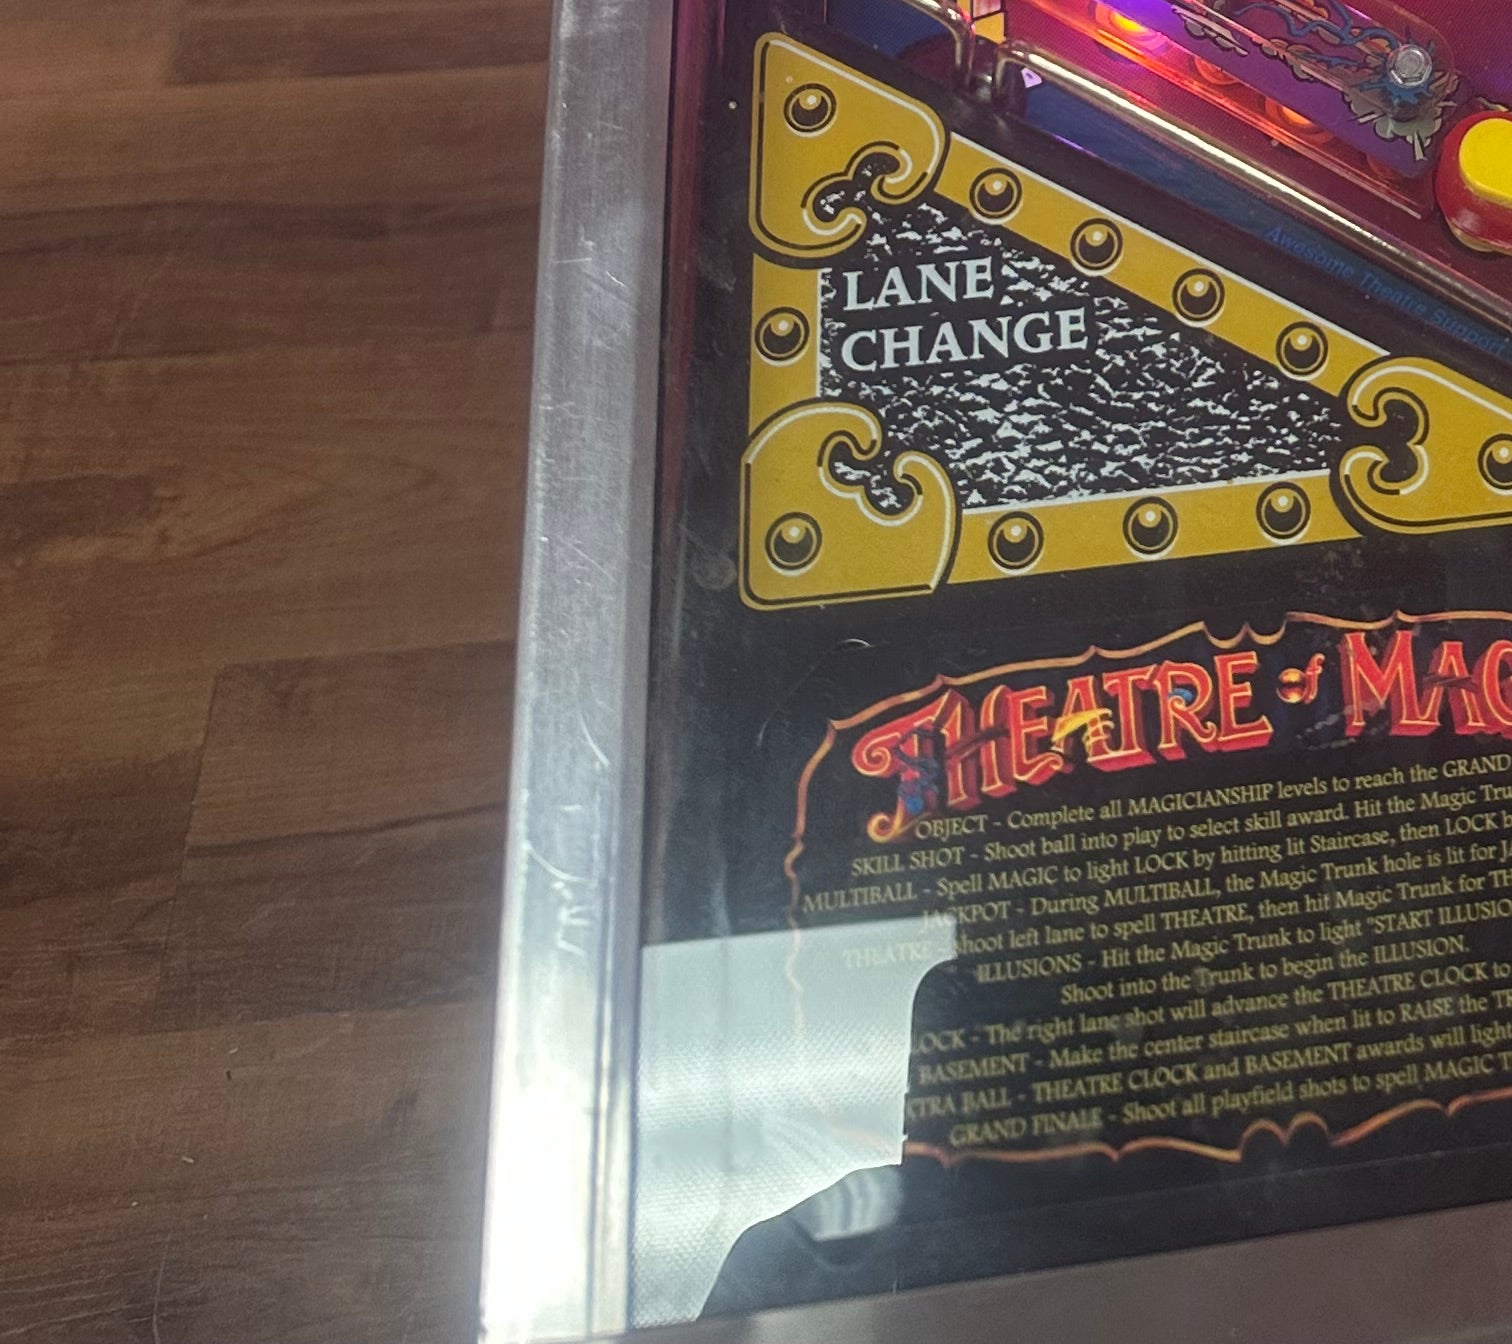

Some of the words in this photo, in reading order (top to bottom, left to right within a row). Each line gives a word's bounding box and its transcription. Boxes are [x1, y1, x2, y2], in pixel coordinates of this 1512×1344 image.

[843, 257, 994, 311] LANE
[841, 307, 1089, 372] CHANGE
[852, 646, 1274, 843] THEATRE
[1276, 653, 1326, 704] of
[850, 855, 904, 876] SKILL
[908, 848, 966, 870] SHOT
[983, 840, 1036, 861] Shoot
[1041, 835, 1077, 854] ball
[1081, 830, 1118, 849] into
[1123, 825, 1164, 849] play
[1166, 822, 1186, 839] to
[1188, 816, 1239, 836] select
[1244, 811, 1282, 830] skill
[1285, 803, 1349, 825] award.
[1354, 799, 1382, 817] Hit
[1387, 795, 1416, 813] the
[1419, 787, 1477, 813] Magic
[915, 816, 990, 844] OBJECT
[1007, 804, 1096, 833] Complete
[1098, 801, 1122, 818] all
[1126, 782, 1275, 815] MAGICIANSHIP
[1277, 776, 1327, 797] levels
[1332, 773, 1350, 790] to
[1354, 767, 1404, 788] reach
[1409, 763, 1439, 781] the
[1442, 754, 1512, 777] GRAND
[802, 882, 917, 910] MULTIBALL
[936, 874, 983, 899] Spell
[987, 865, 1059, 889] MAGIC
[1063, 863, 1082, 880] to
[1086, 857, 1130, 881] light
[1134, 850, 1189, 871] LOCK
[1192, 847, 1216, 869] by
[1220, 839, 1282, 866] hitting
[1286, 837, 1305, 854] lit
[1310, 826, 1396, 852] Staircase,
[1399, 821, 1440, 840] then
[1445, 814, 1498, 835] LOCK
